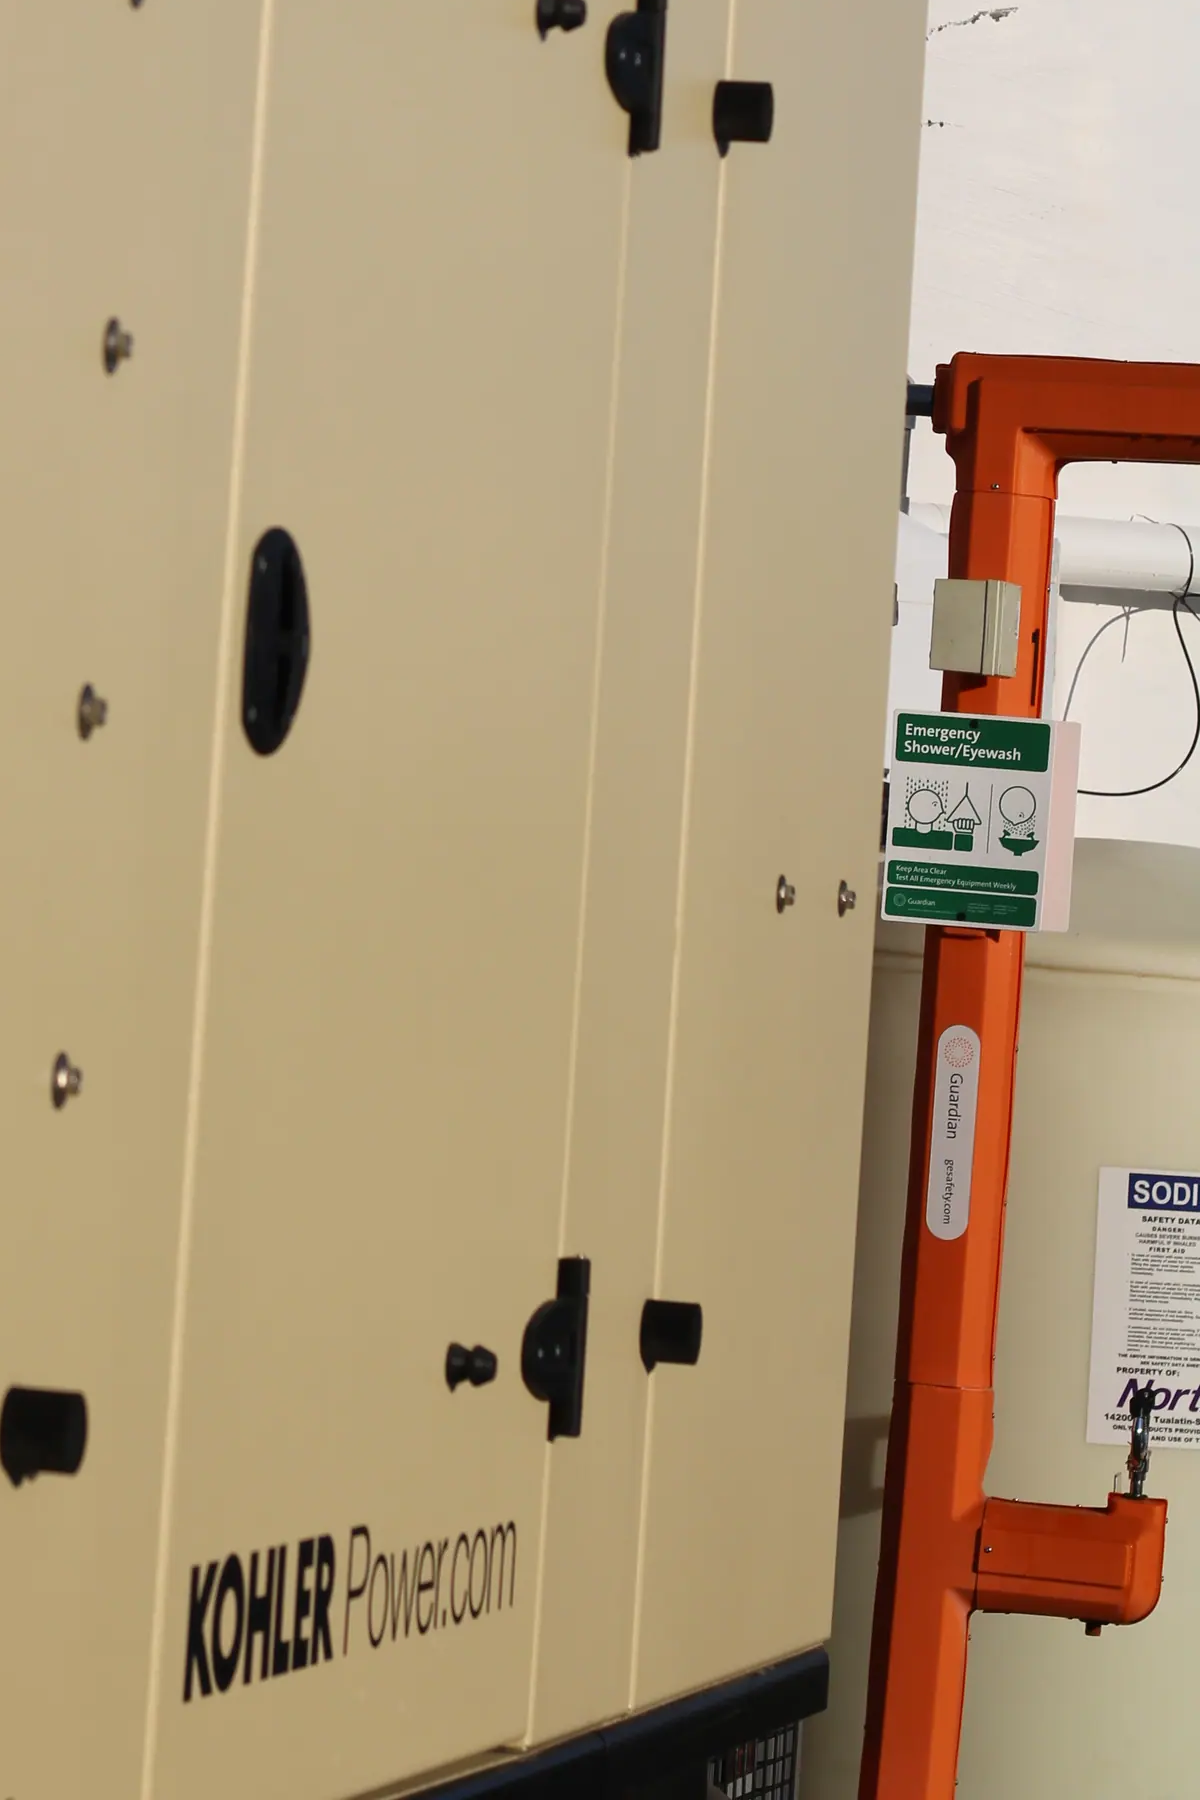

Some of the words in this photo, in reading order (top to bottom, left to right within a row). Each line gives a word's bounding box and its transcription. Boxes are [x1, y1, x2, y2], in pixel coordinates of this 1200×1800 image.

[905, 723, 981, 744] Emergency
[904, 740, 1021, 761] Shower/Eyewash
[895, 865, 912, 874] Keep
[913, 866, 928, 874] Area
[930, 867, 946, 875] Clear
[920, 876, 956, 887] Emergency
[957, 879, 992, 889] Equipment
[993, 881, 1017, 891] Weekly
[907, 897, 936, 906] Guardian
[946, 1073, 964, 1139] Guardian
[942, 1159, 954, 1225] gesafety.com
[1133, 1180, 1198, 1207] SODI
[1142, 1216, 1175, 1224] SAFETY
[1178, 1217, 1200, 1225] DATA
[1116, 1367, 1163, 1376] PROPERTY
[1165, 1369, 1180, 1377] OF:
[183, 1534, 336, 1704] KOHLER
[342, 1520, 517, 1657] Power.com
